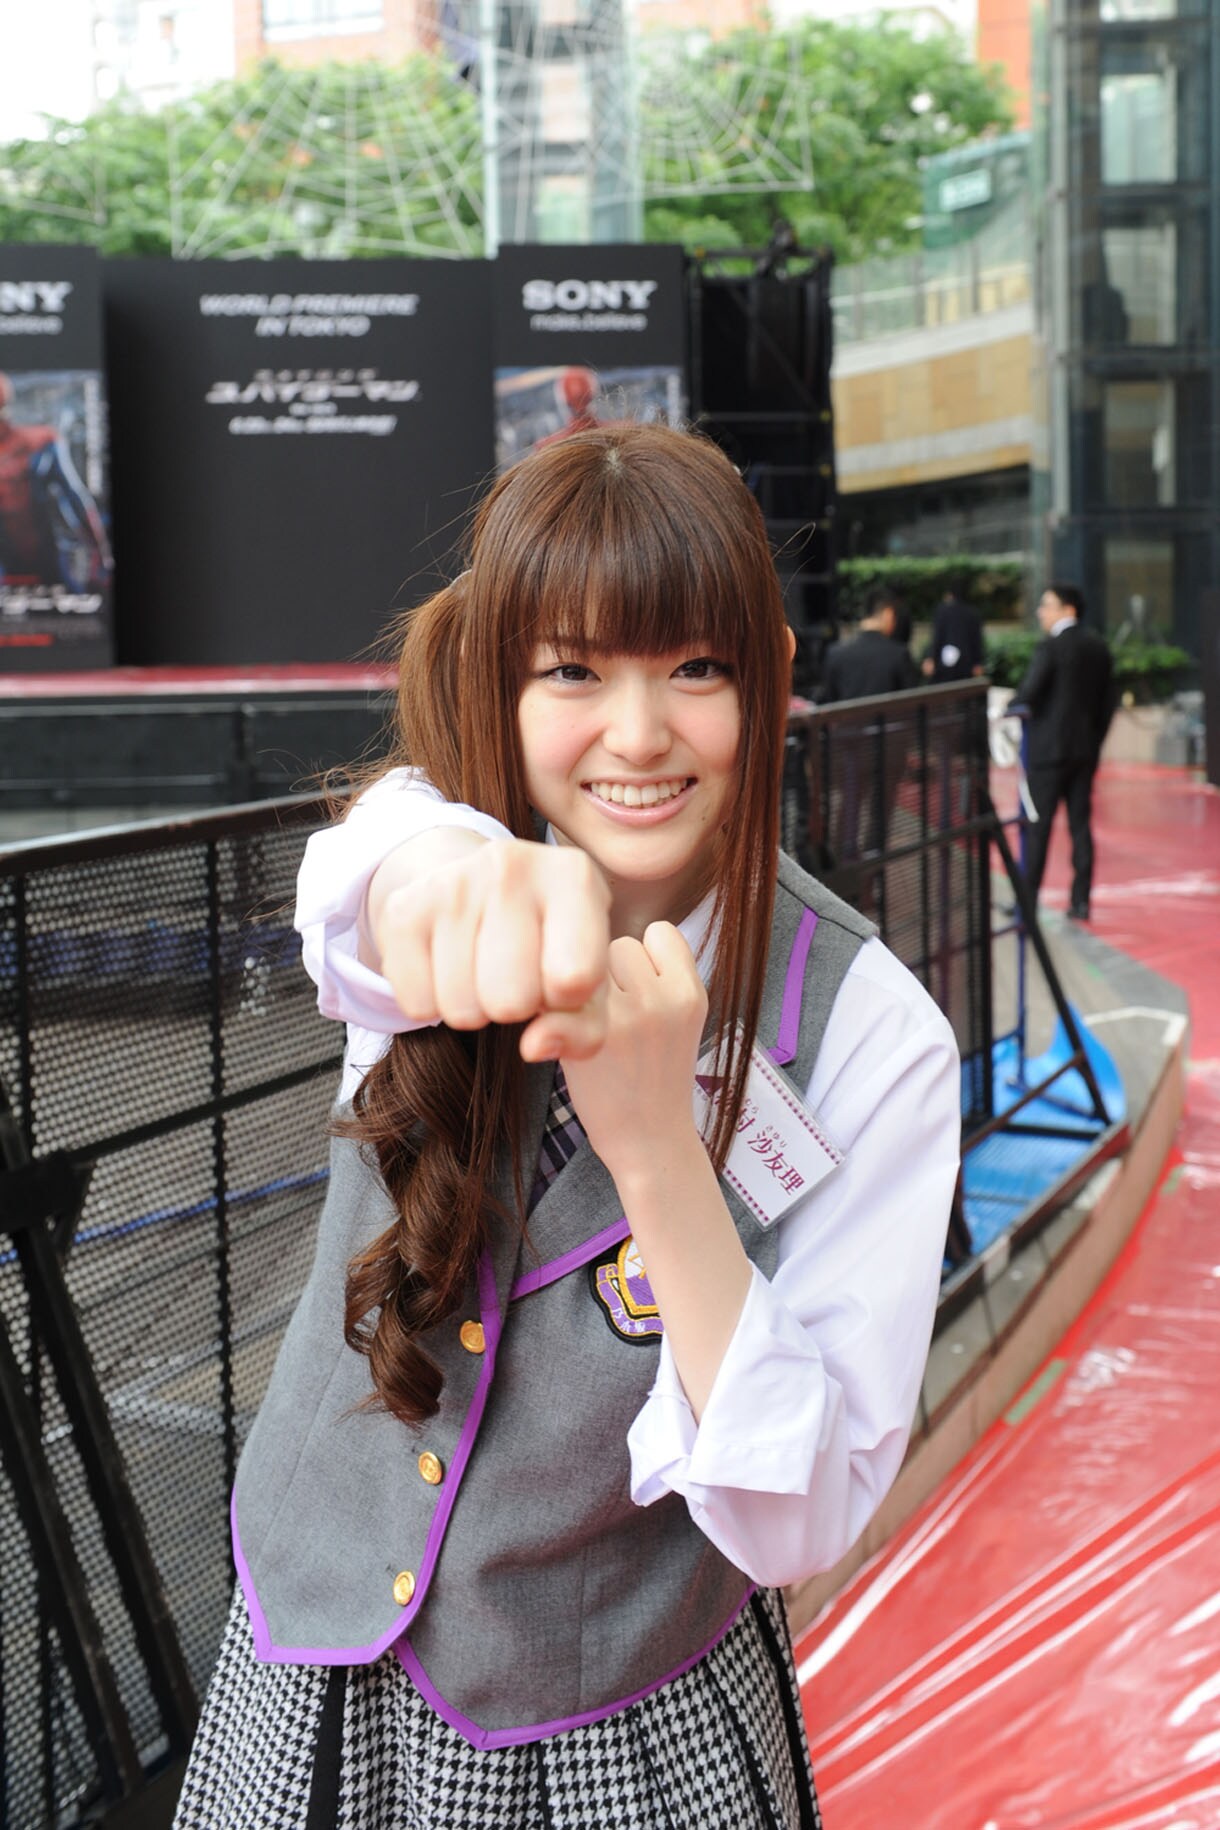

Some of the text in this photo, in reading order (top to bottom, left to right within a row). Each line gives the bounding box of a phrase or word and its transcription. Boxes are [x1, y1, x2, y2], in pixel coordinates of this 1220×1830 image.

[200, 294, 419, 315] WORLD PREMIERE
[522, 279, 657, 310] SONY
[255, 315, 371, 337] IN TOKYO
[747, 1130, 805, 1195] 沙友理
